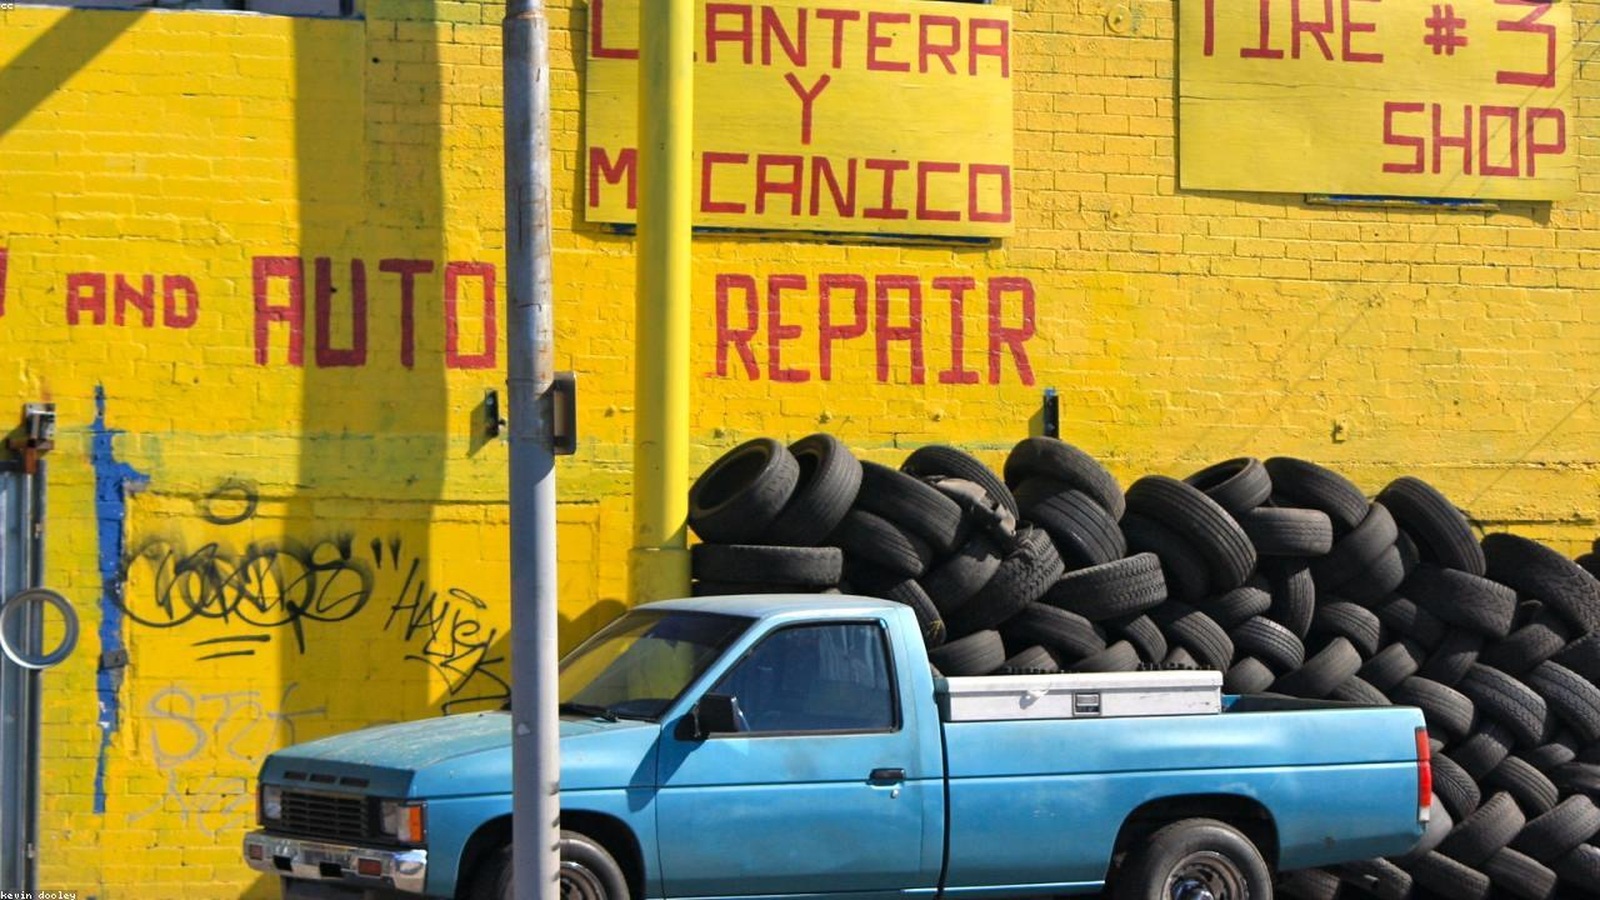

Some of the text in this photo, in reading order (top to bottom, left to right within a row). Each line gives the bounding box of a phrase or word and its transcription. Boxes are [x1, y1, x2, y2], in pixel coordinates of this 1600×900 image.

[590, 0, 1010, 79] LANTERA
[785, 72, 830, 145] Y
[1382, 101, 1566, 177] SHOP
[589, 147, 1012, 223] MCANICO
[67, 272, 199, 329] AND
[252, 256, 497, 370] AUTO
[715, 273, 1036, 386] REPAIR
